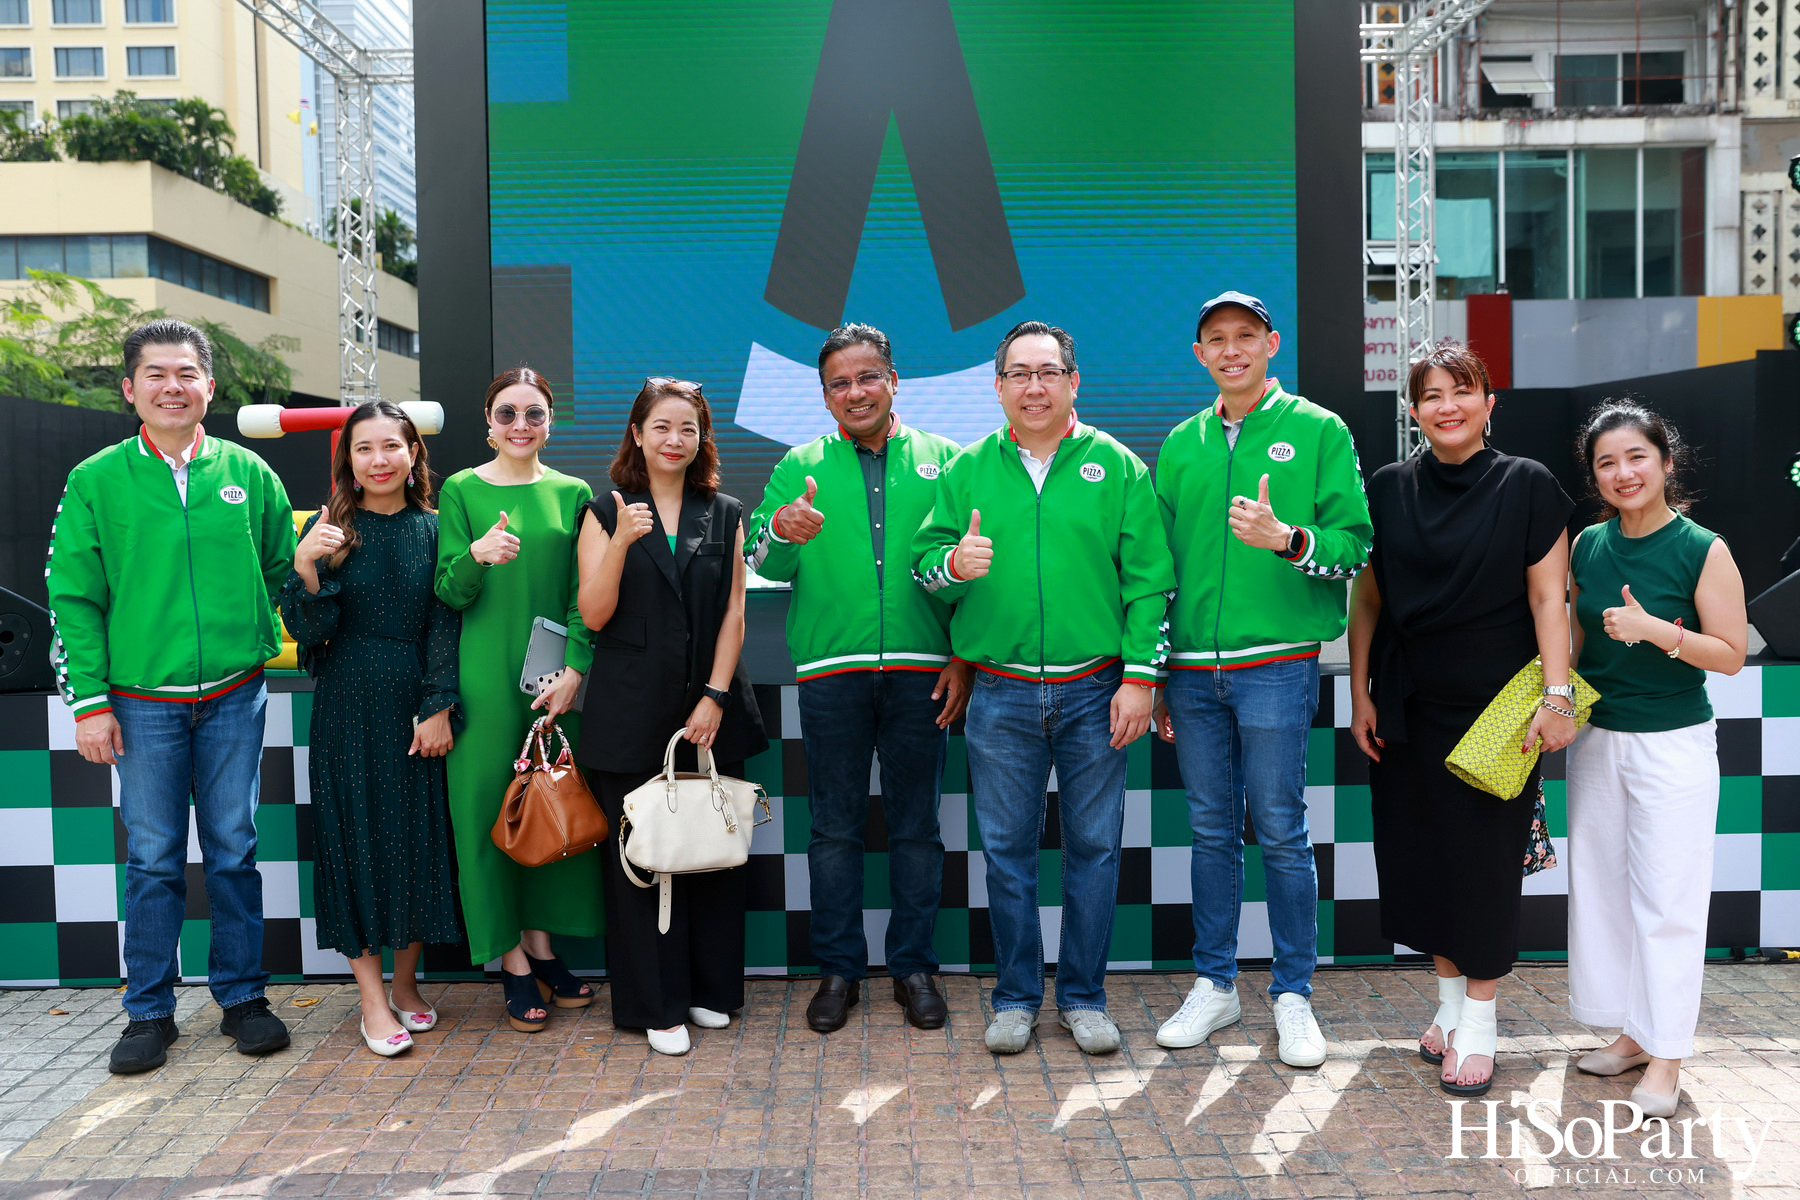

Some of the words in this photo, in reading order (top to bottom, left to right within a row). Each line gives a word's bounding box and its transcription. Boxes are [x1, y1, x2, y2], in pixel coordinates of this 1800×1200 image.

[1271, 446, 1291, 457] PIZZA
[919, 467, 938, 475] PIZZA
[1083, 466, 1102, 477] PIZZA
[223, 490, 243, 498] PIZZA
